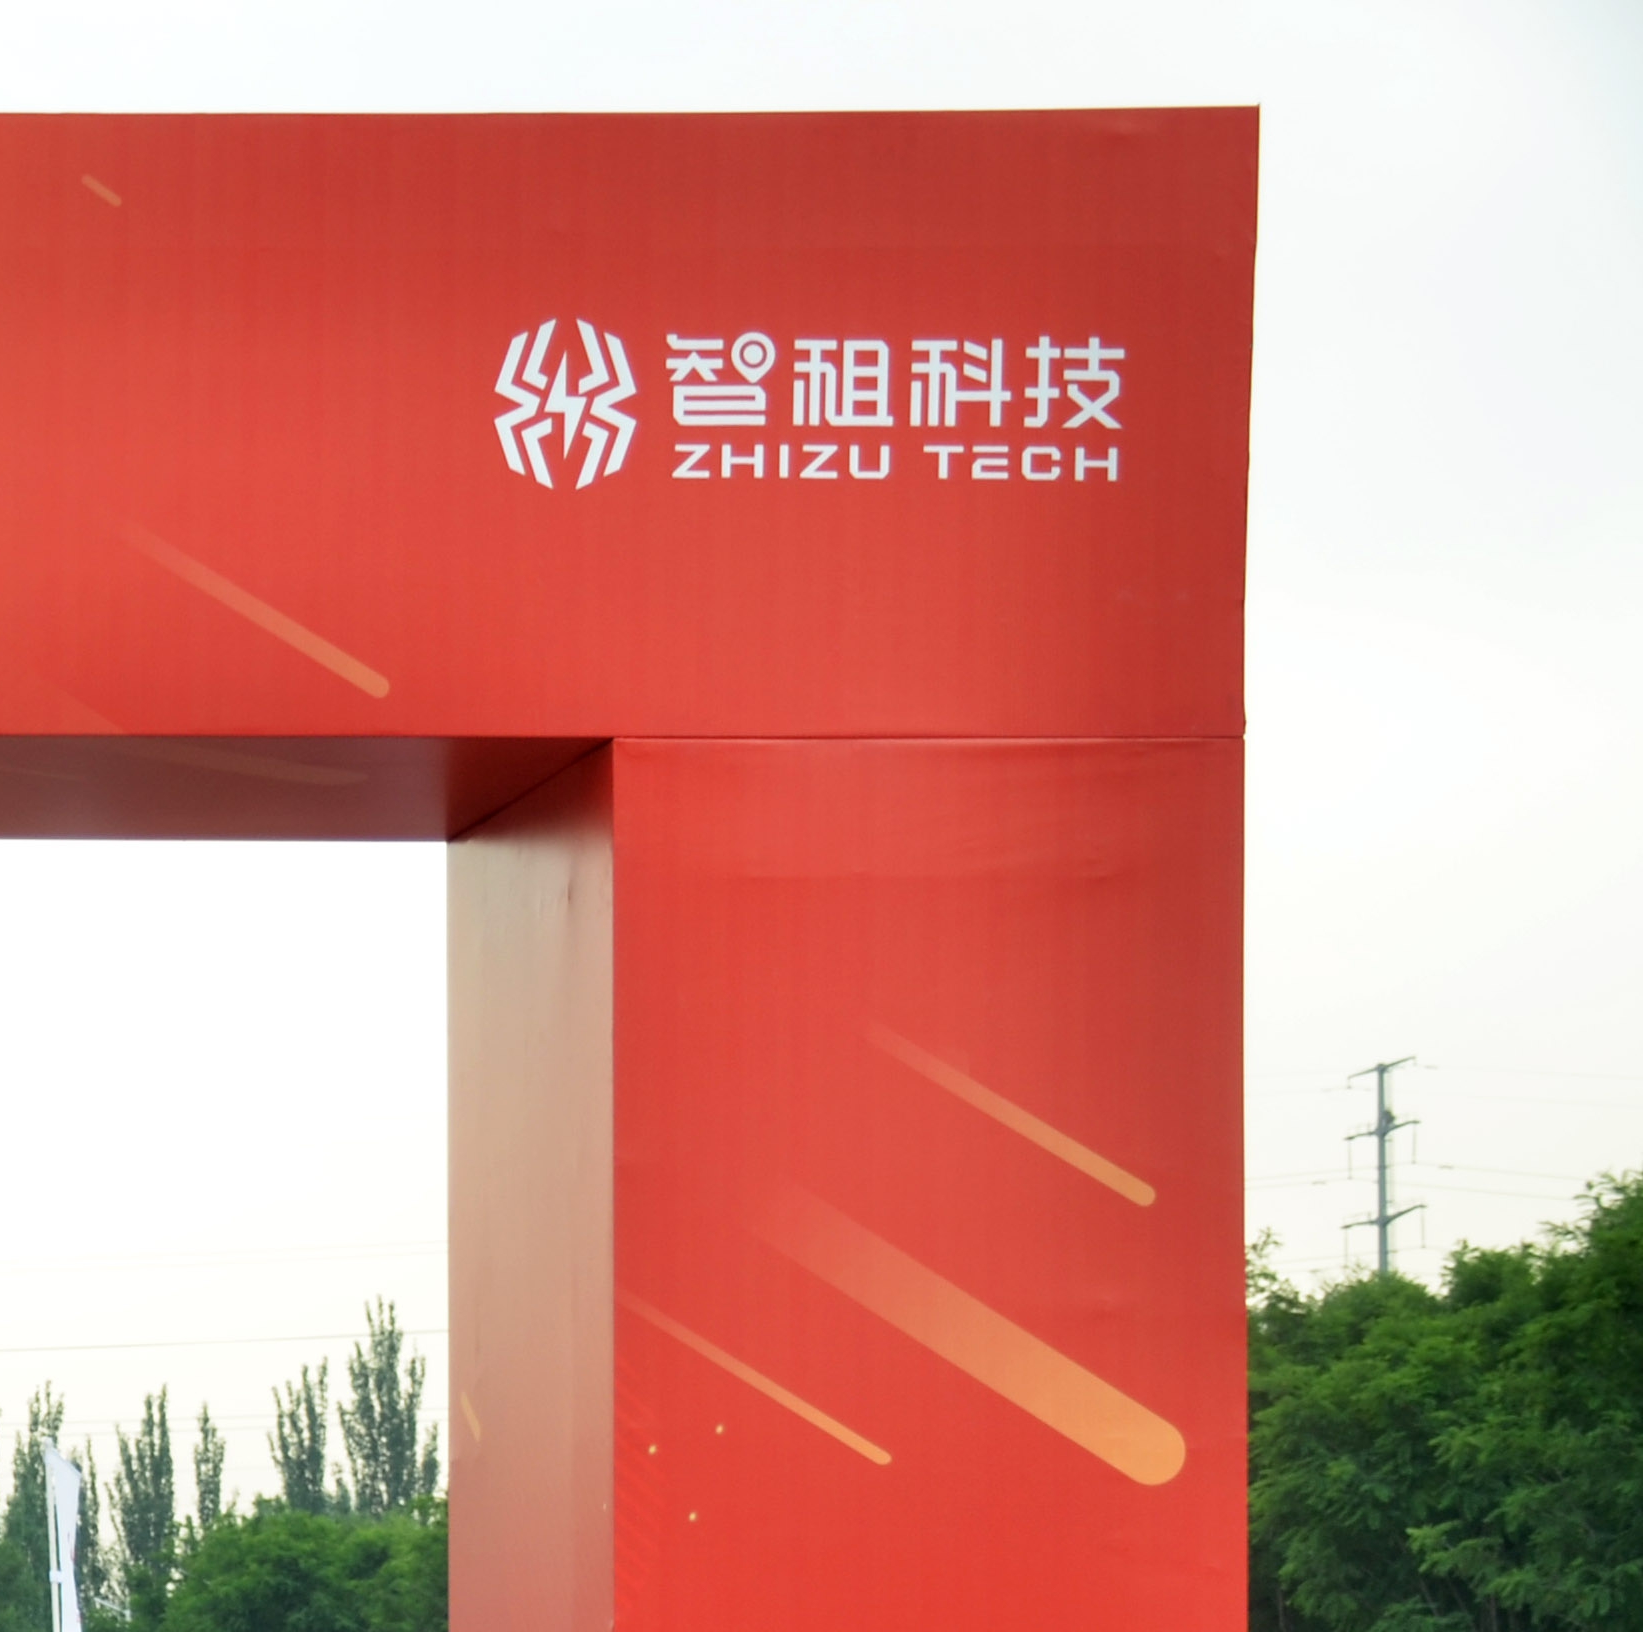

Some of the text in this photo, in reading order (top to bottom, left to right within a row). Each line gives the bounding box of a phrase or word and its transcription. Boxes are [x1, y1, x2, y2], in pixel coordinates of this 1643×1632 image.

[665, 331, 1126, 429] 智租科技
[671, 444, 1119, 482] ZHIZU TECH
